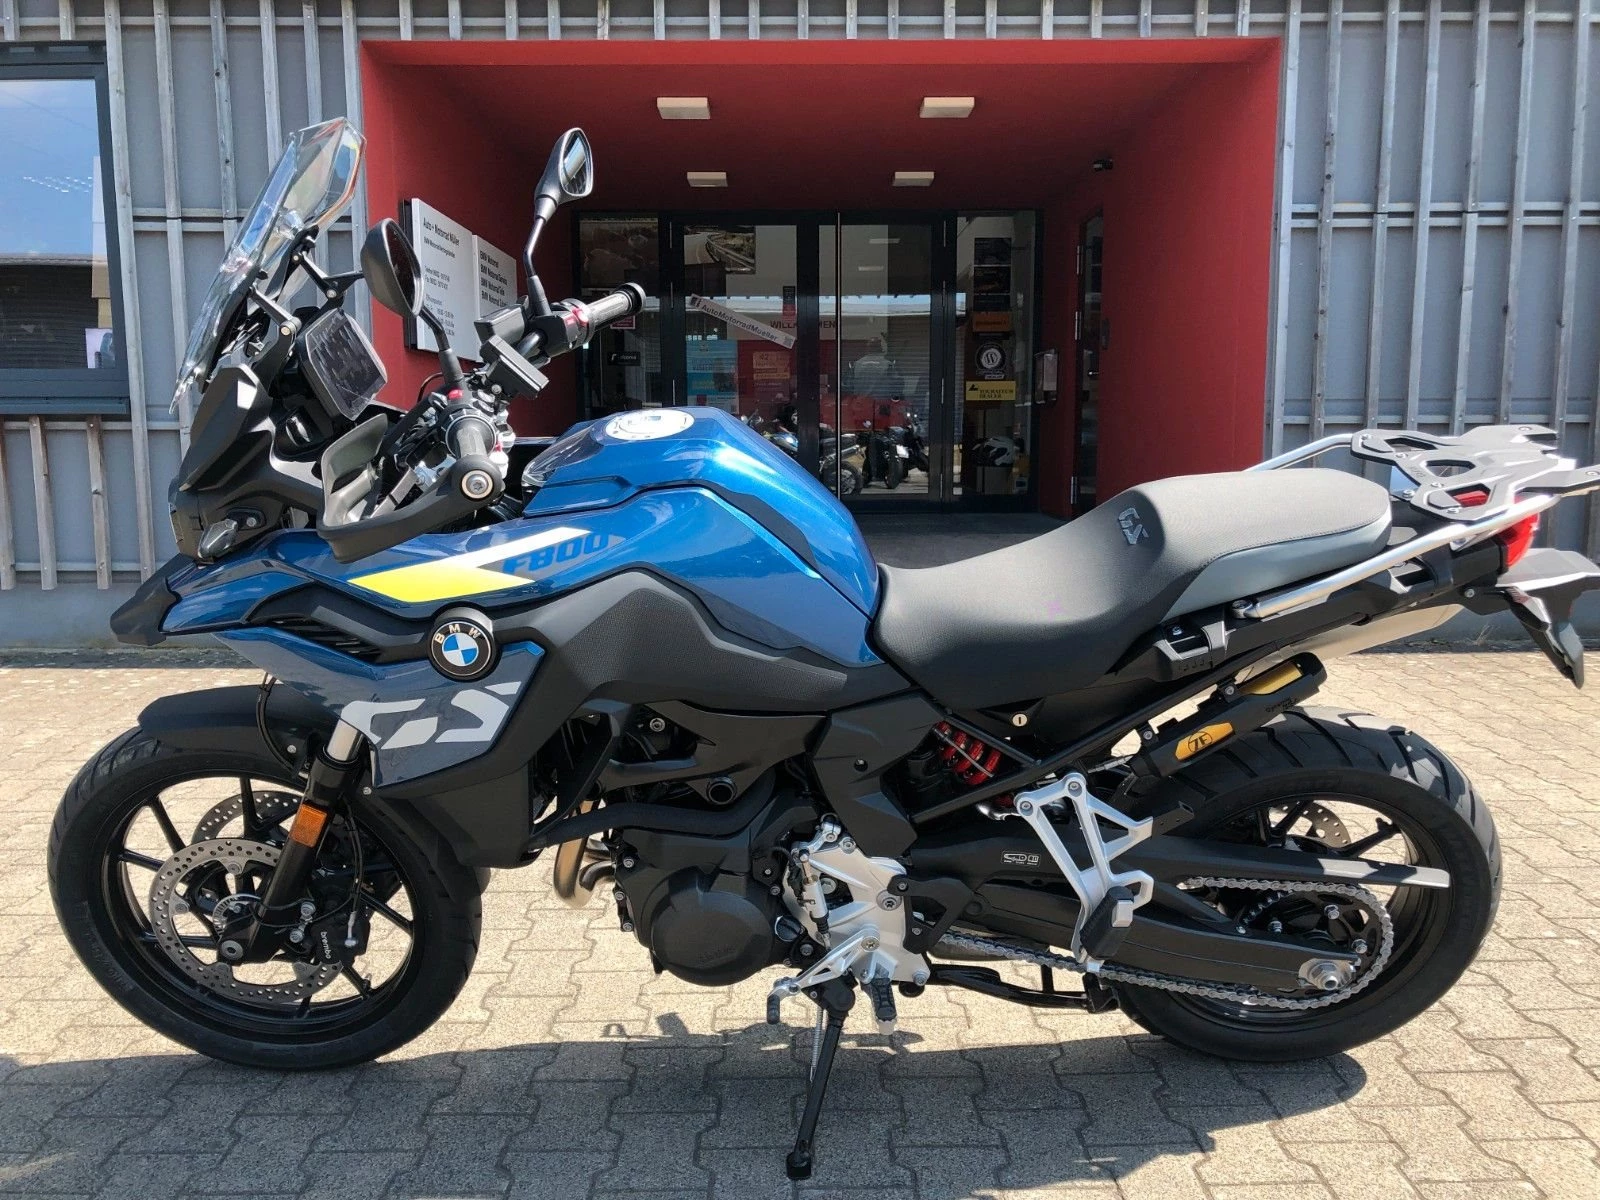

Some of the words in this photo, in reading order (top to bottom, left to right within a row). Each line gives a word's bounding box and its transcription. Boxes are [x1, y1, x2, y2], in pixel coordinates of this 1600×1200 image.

[701, 304, 778, 341] AutoMotorradMueller
[501, 534, 610, 574] F800
[435, 623, 482, 645] BMW
[320, 931, 332, 959] brembo
